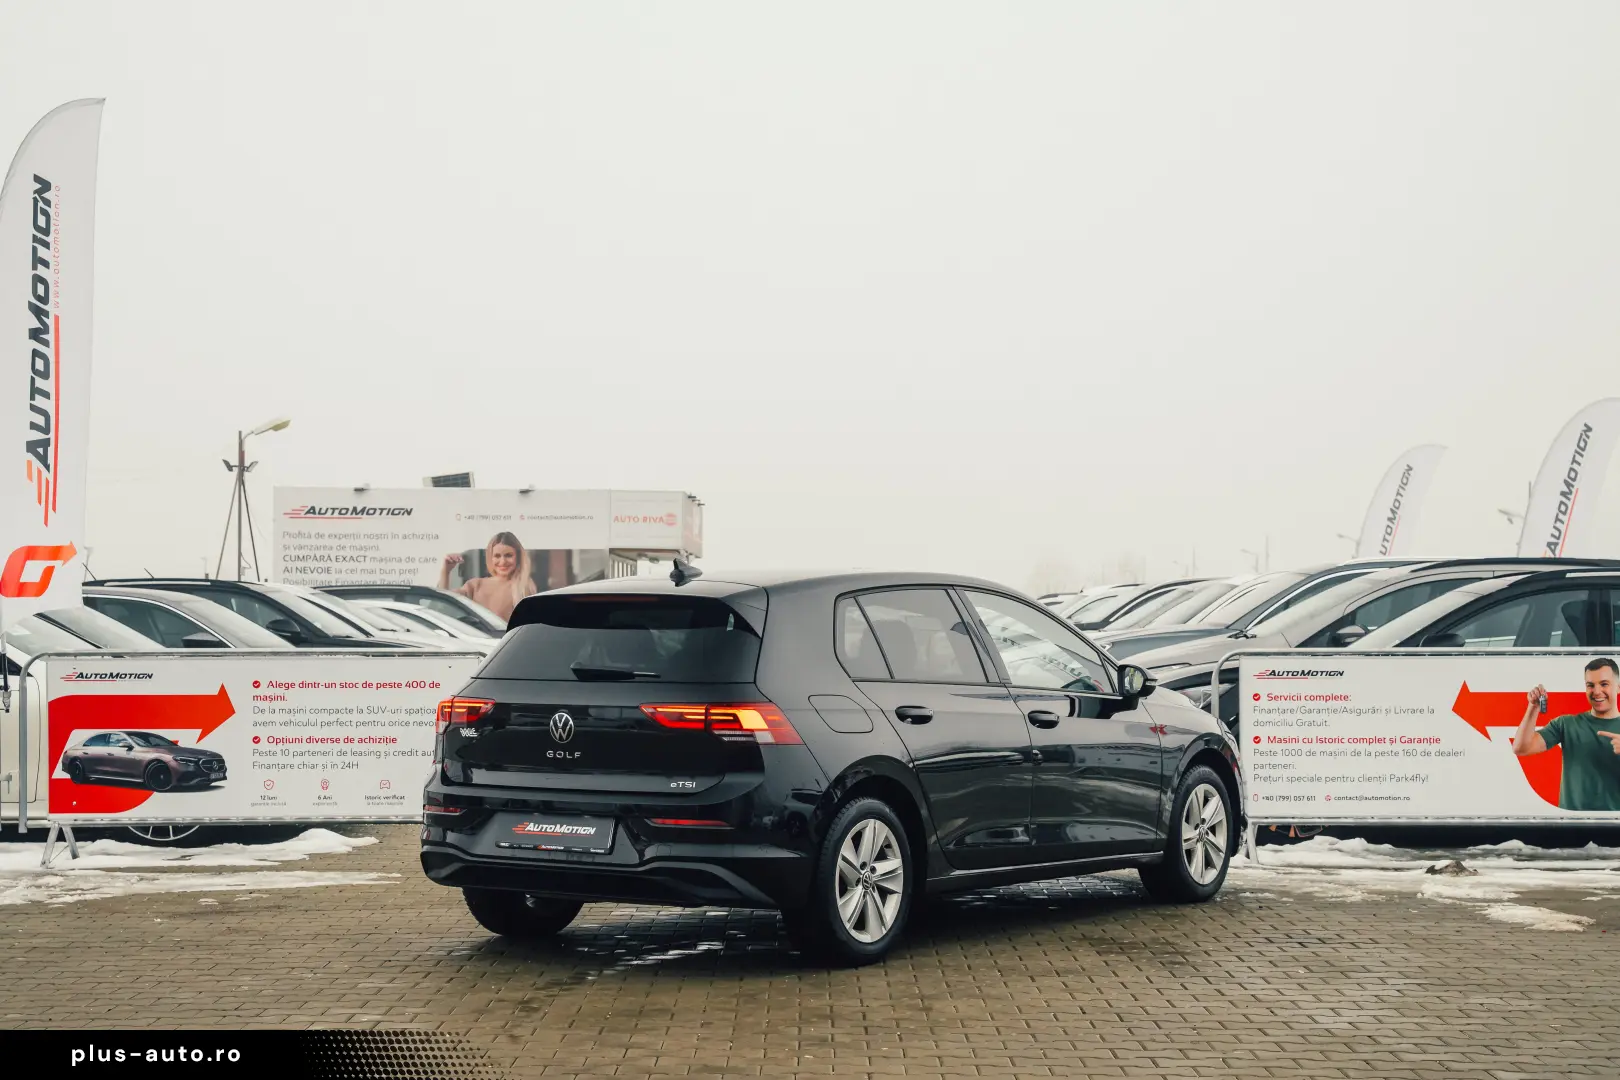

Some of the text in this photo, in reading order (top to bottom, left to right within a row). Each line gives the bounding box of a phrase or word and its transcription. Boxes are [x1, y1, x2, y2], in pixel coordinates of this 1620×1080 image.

[53, 184, 61, 310] www.automotion.ro
[1379, 464, 1413, 556] UTOMOTION
[613, 515, 640, 523] AUTO
[314, 531, 324, 540] de
[336, 543, 346, 551] de
[335, 555, 367, 563] EXACT
[282, 566, 293, 574] AI
[295, 566, 332, 574] NEVOIE
[345, 567, 357, 575] cel
[379, 567, 396, 575] bun
[266, 680, 440, 691] Alege dintr-un stoc de peste 400 de
[253, 693, 288, 703] mașini.
[1267, 693, 1352, 704] Servicii complete:
[253, 706, 436, 717] De la mașini compacte la SUV-uri spațioa
[1385, 706, 1391, 717] și
[1393, 706, 1425, 714] Livrare
[1427, 706, 1435, 714] la
[279, 719, 318, 727] vehiculul
[320, 719, 353, 729] perfect
[356, 719, 385, 729] pentru
[388, 719, 410, 727] orice
[1253, 719, 1330, 727] domiciliu Gratuit.
[267, 735, 397, 746] Opțiuni diverse de achiziție
[1267, 736, 1299, 744] Masini
[1316, 736, 1345, 744] Istoric
[1348, 736, 1386, 746] complet
[1389, 736, 1396, 746] și
[1399, 736, 1441, 746] Garanție
[253, 749, 435, 759] Peste 10 parteneri de leasing și credit aut
[546, 751, 581, 759] GOLF
[1253, 749, 1465, 759] Peste 1000 de mașini de la peste 160 de dealeri
[253, 761, 359, 772] Finanțare chiar și în 24H
[1253, 762, 1297, 772] parteneri.
[1254, 774, 1429, 785] Prețuri speciale pentru clienții Park4fly!
